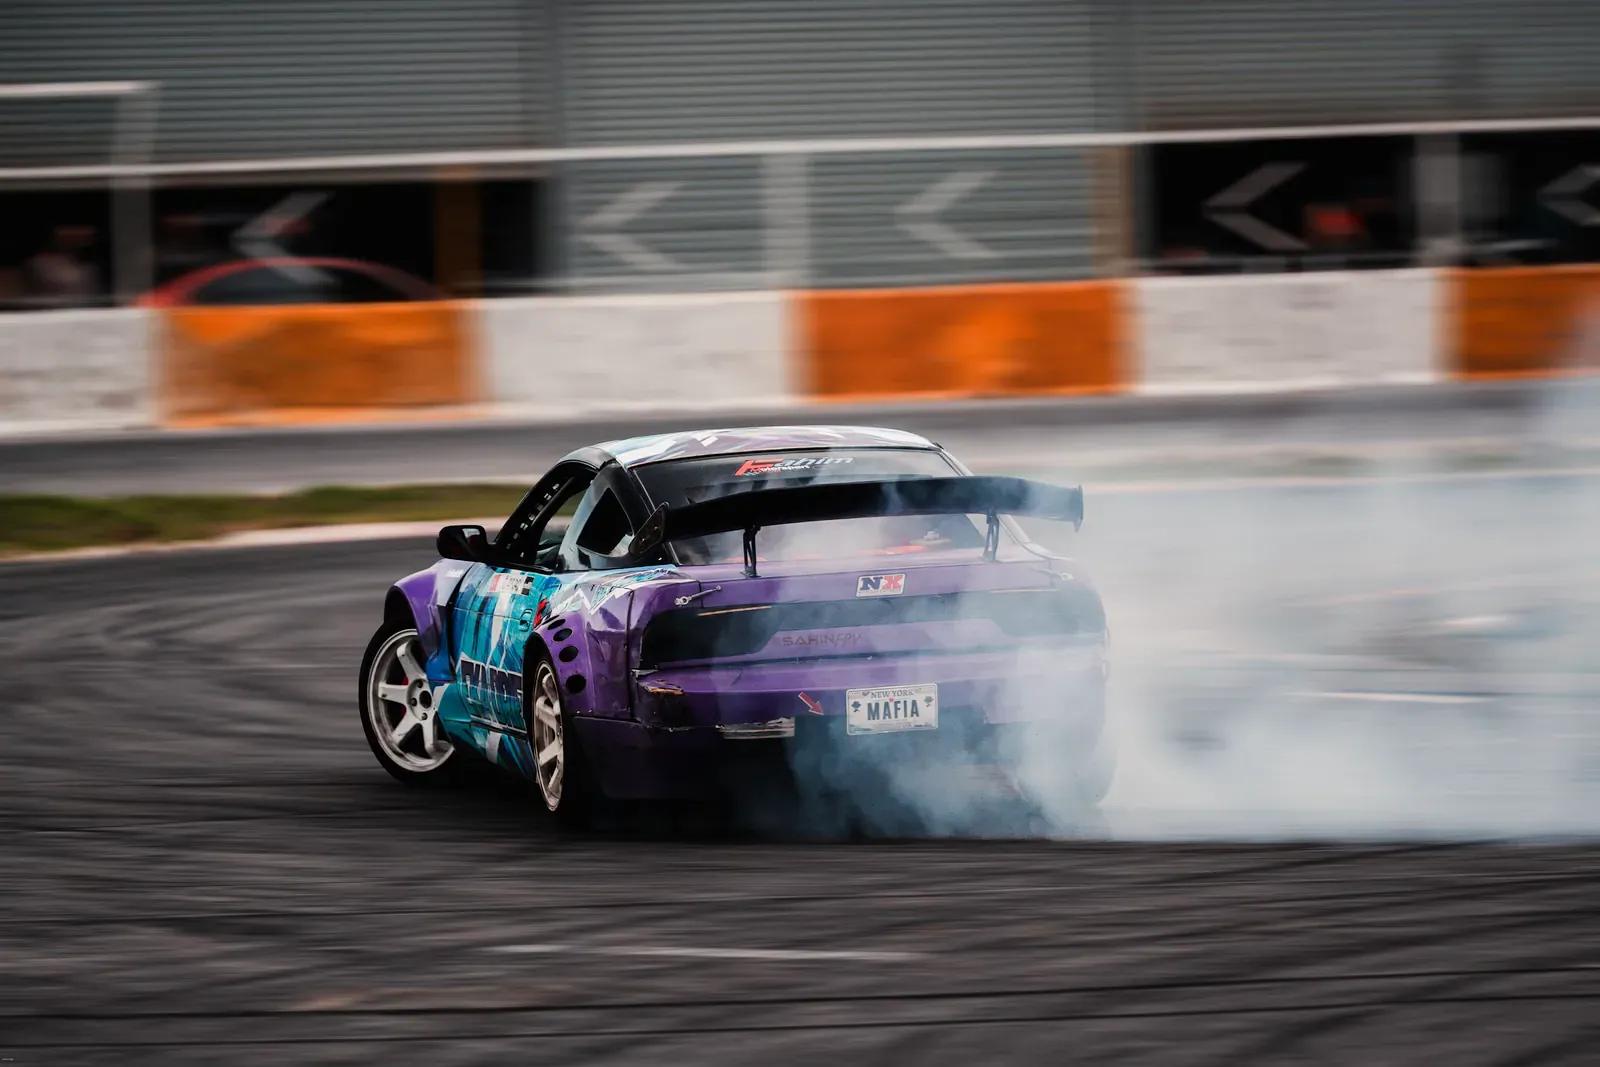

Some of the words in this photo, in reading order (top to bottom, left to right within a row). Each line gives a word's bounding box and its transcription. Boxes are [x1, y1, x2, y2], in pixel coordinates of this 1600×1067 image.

[859, 574, 903, 591] NX
[870, 690, 891, 699] NEW
[891, 688, 914, 698] YORK
[867, 699, 919, 721] MAFIA
